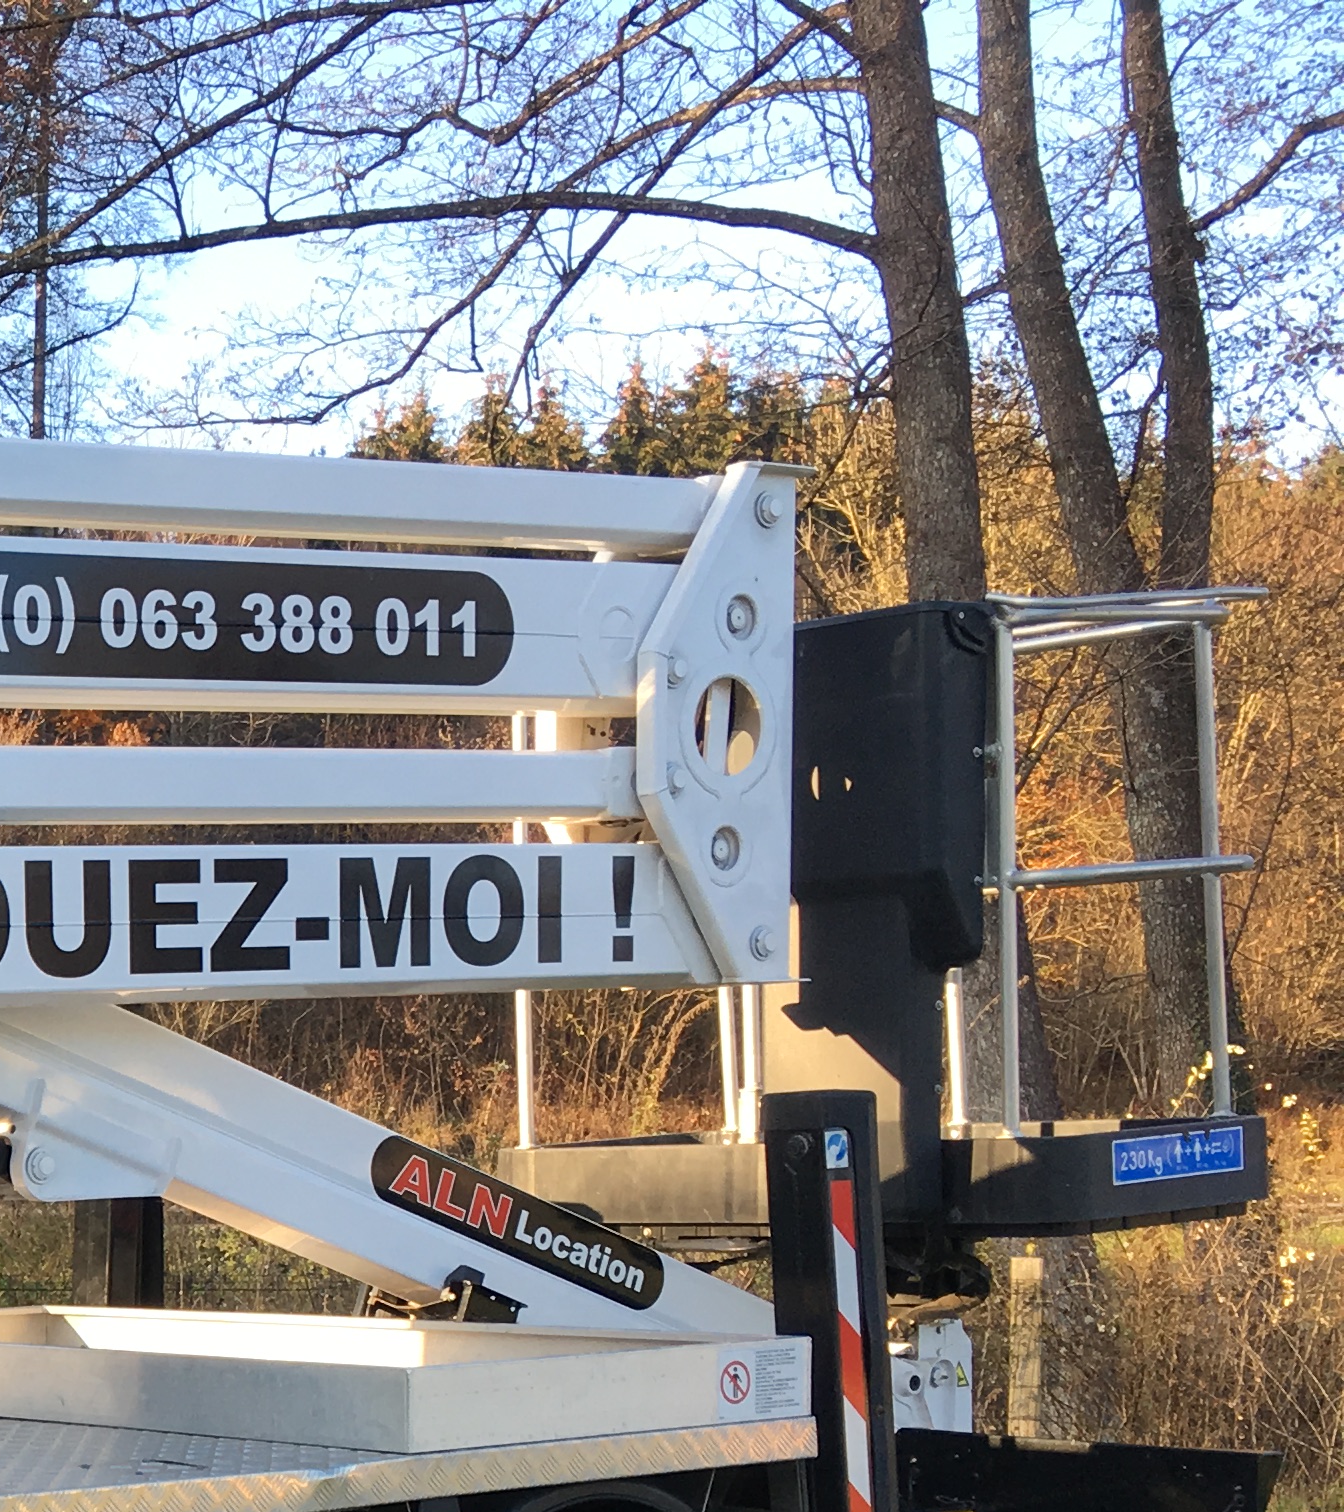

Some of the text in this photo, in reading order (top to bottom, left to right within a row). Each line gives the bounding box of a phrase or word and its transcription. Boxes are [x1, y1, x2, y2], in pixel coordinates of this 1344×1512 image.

[99, 586, 219, 651] 063
[240, 592, 355, 655] 388
[374, 597, 477, 658] 011
[610, 854, 636, 963] !
[387, 1154, 645, 1294] ALN Location
